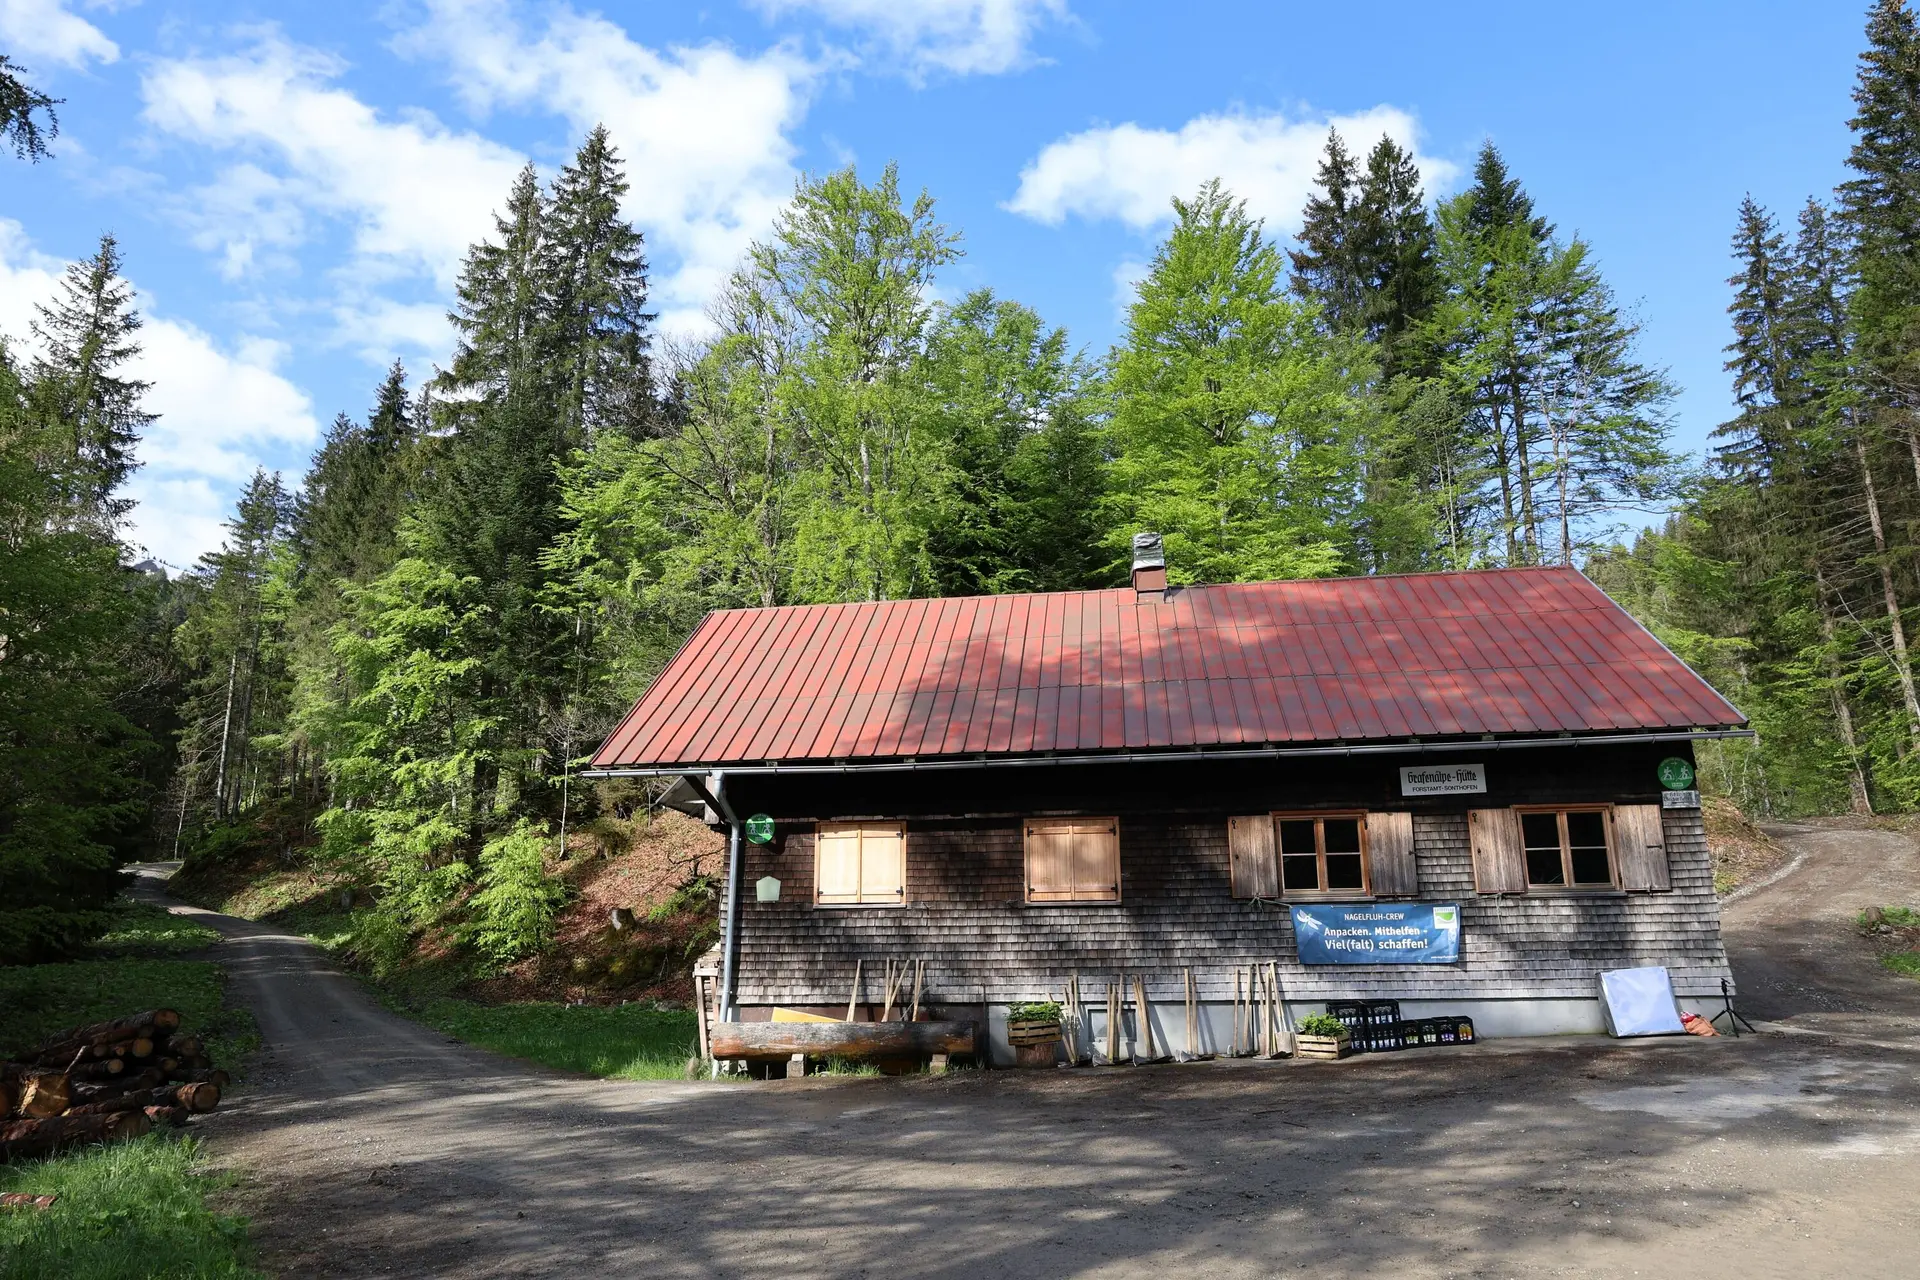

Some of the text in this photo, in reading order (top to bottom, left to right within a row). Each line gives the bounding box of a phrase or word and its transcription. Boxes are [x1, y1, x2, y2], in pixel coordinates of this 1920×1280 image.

[1344, 913, 1404, 921] NAGELFLUH-CREW
[1324, 927, 1371, 938] Anpacken.
[1374, 926, 1420, 936] Mithelfen
[1325, 938, 1428, 953] Viel(falt) schaffen!
